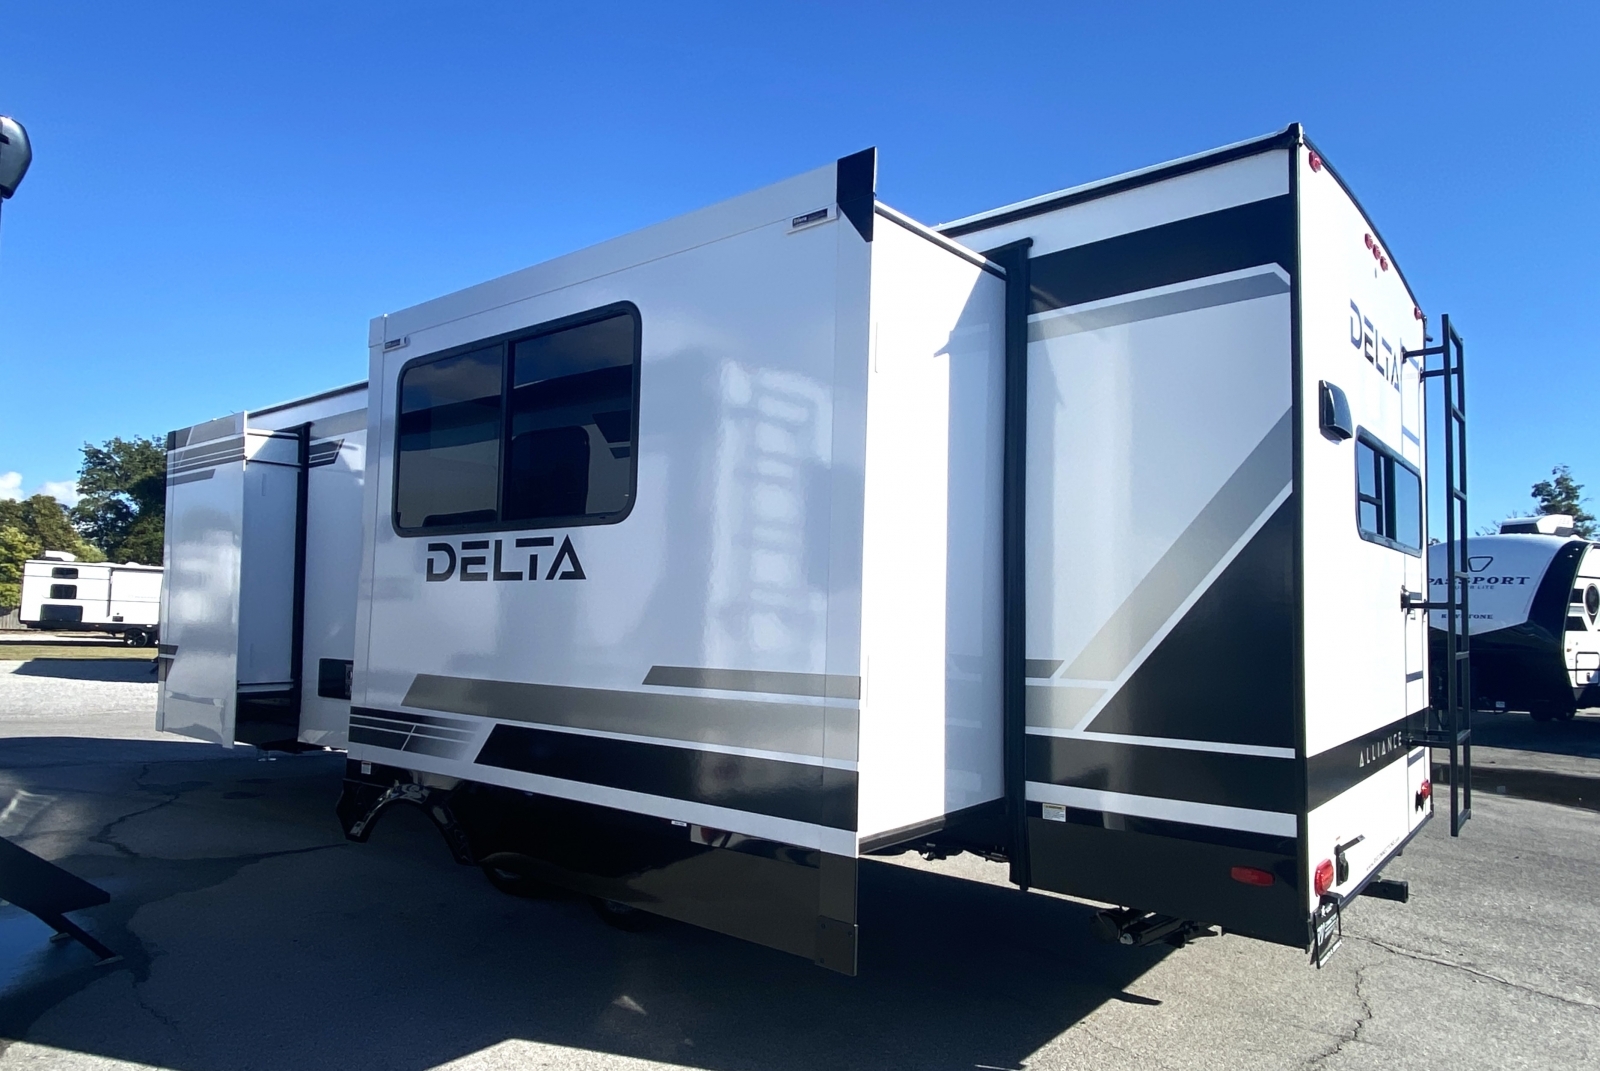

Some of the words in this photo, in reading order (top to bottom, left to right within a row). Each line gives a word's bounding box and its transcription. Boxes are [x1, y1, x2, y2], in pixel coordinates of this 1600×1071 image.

[1350, 298, 1400, 393] DELTA
[426, 534, 586, 582] DELTA
[1428, 576, 1530, 586] PAPORT
[1359, 731, 1402, 768] ALLIANCE
